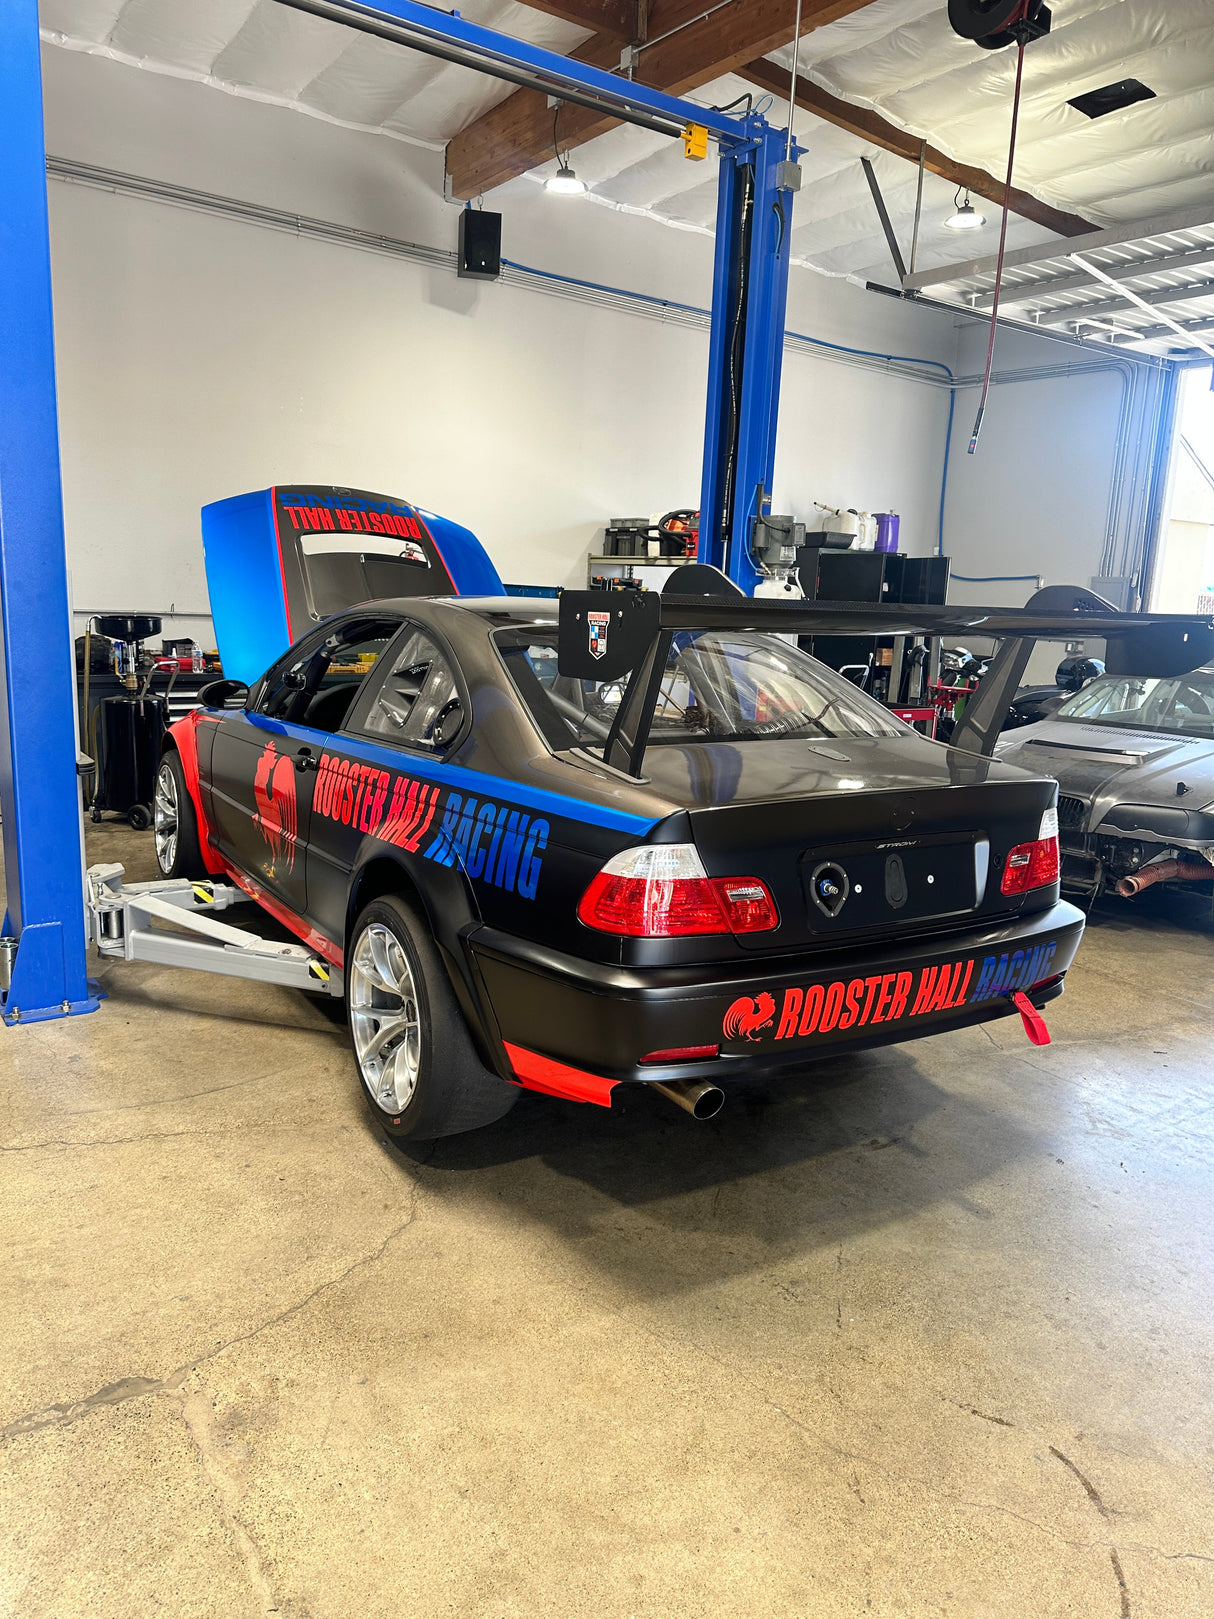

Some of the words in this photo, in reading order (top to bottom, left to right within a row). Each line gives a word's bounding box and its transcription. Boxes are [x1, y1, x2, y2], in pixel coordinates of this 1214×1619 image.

[279, 493, 414, 517] RACING
[283, 506, 336, 530] HALL
[335, 509, 422, 539] ROOSTER
[312, 753, 391, 837] ROOSTER
[376, 776, 441, 854] HALL
[423, 792, 550, 901] RACING
[774, 971, 913, 1040] ROOSTER
[909, 959, 975, 1016] HALL
[969, 941, 1058, 1004] RACING
